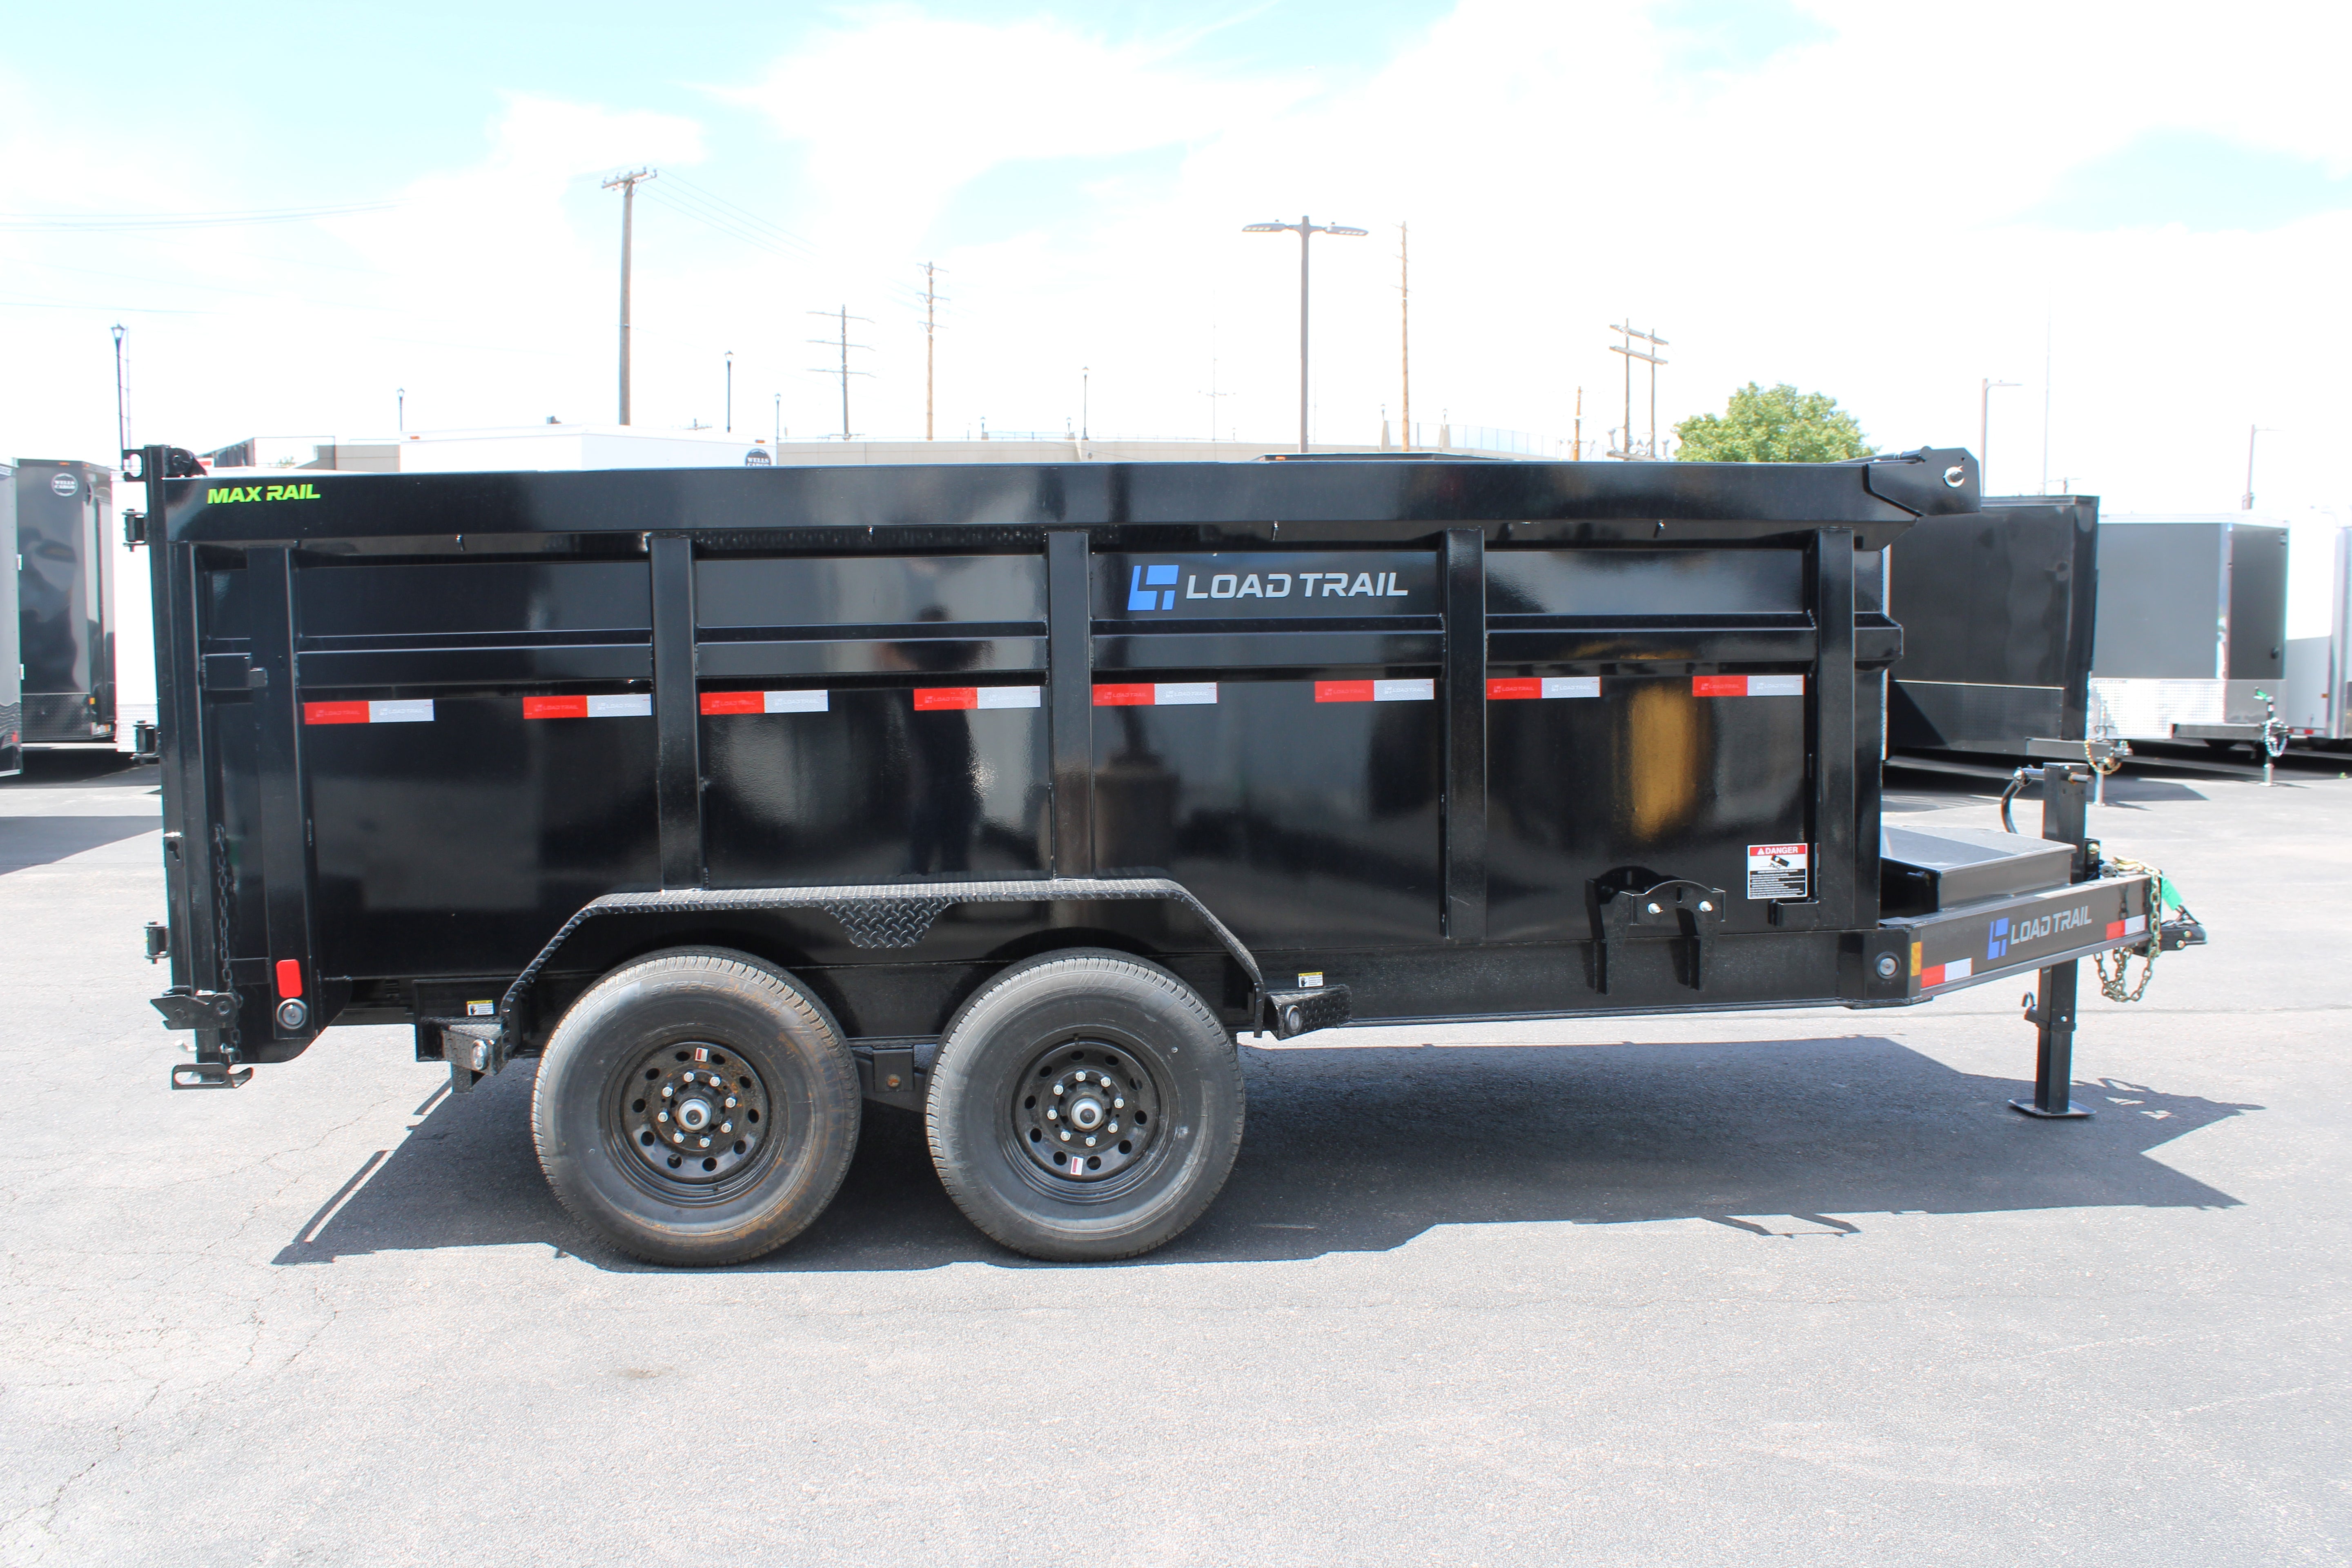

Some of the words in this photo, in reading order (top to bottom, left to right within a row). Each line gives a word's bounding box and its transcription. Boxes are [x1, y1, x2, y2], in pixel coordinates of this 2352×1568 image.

[207, 486, 263, 504] MAX
[266, 483, 321, 501] RAIL
[1186, 573, 1292, 599] LOAD
[1299, 572, 1408, 597] TRAIL
[2011, 916, 2051, 945] LOAD
[2053, 906, 2092, 933] TRAIL
